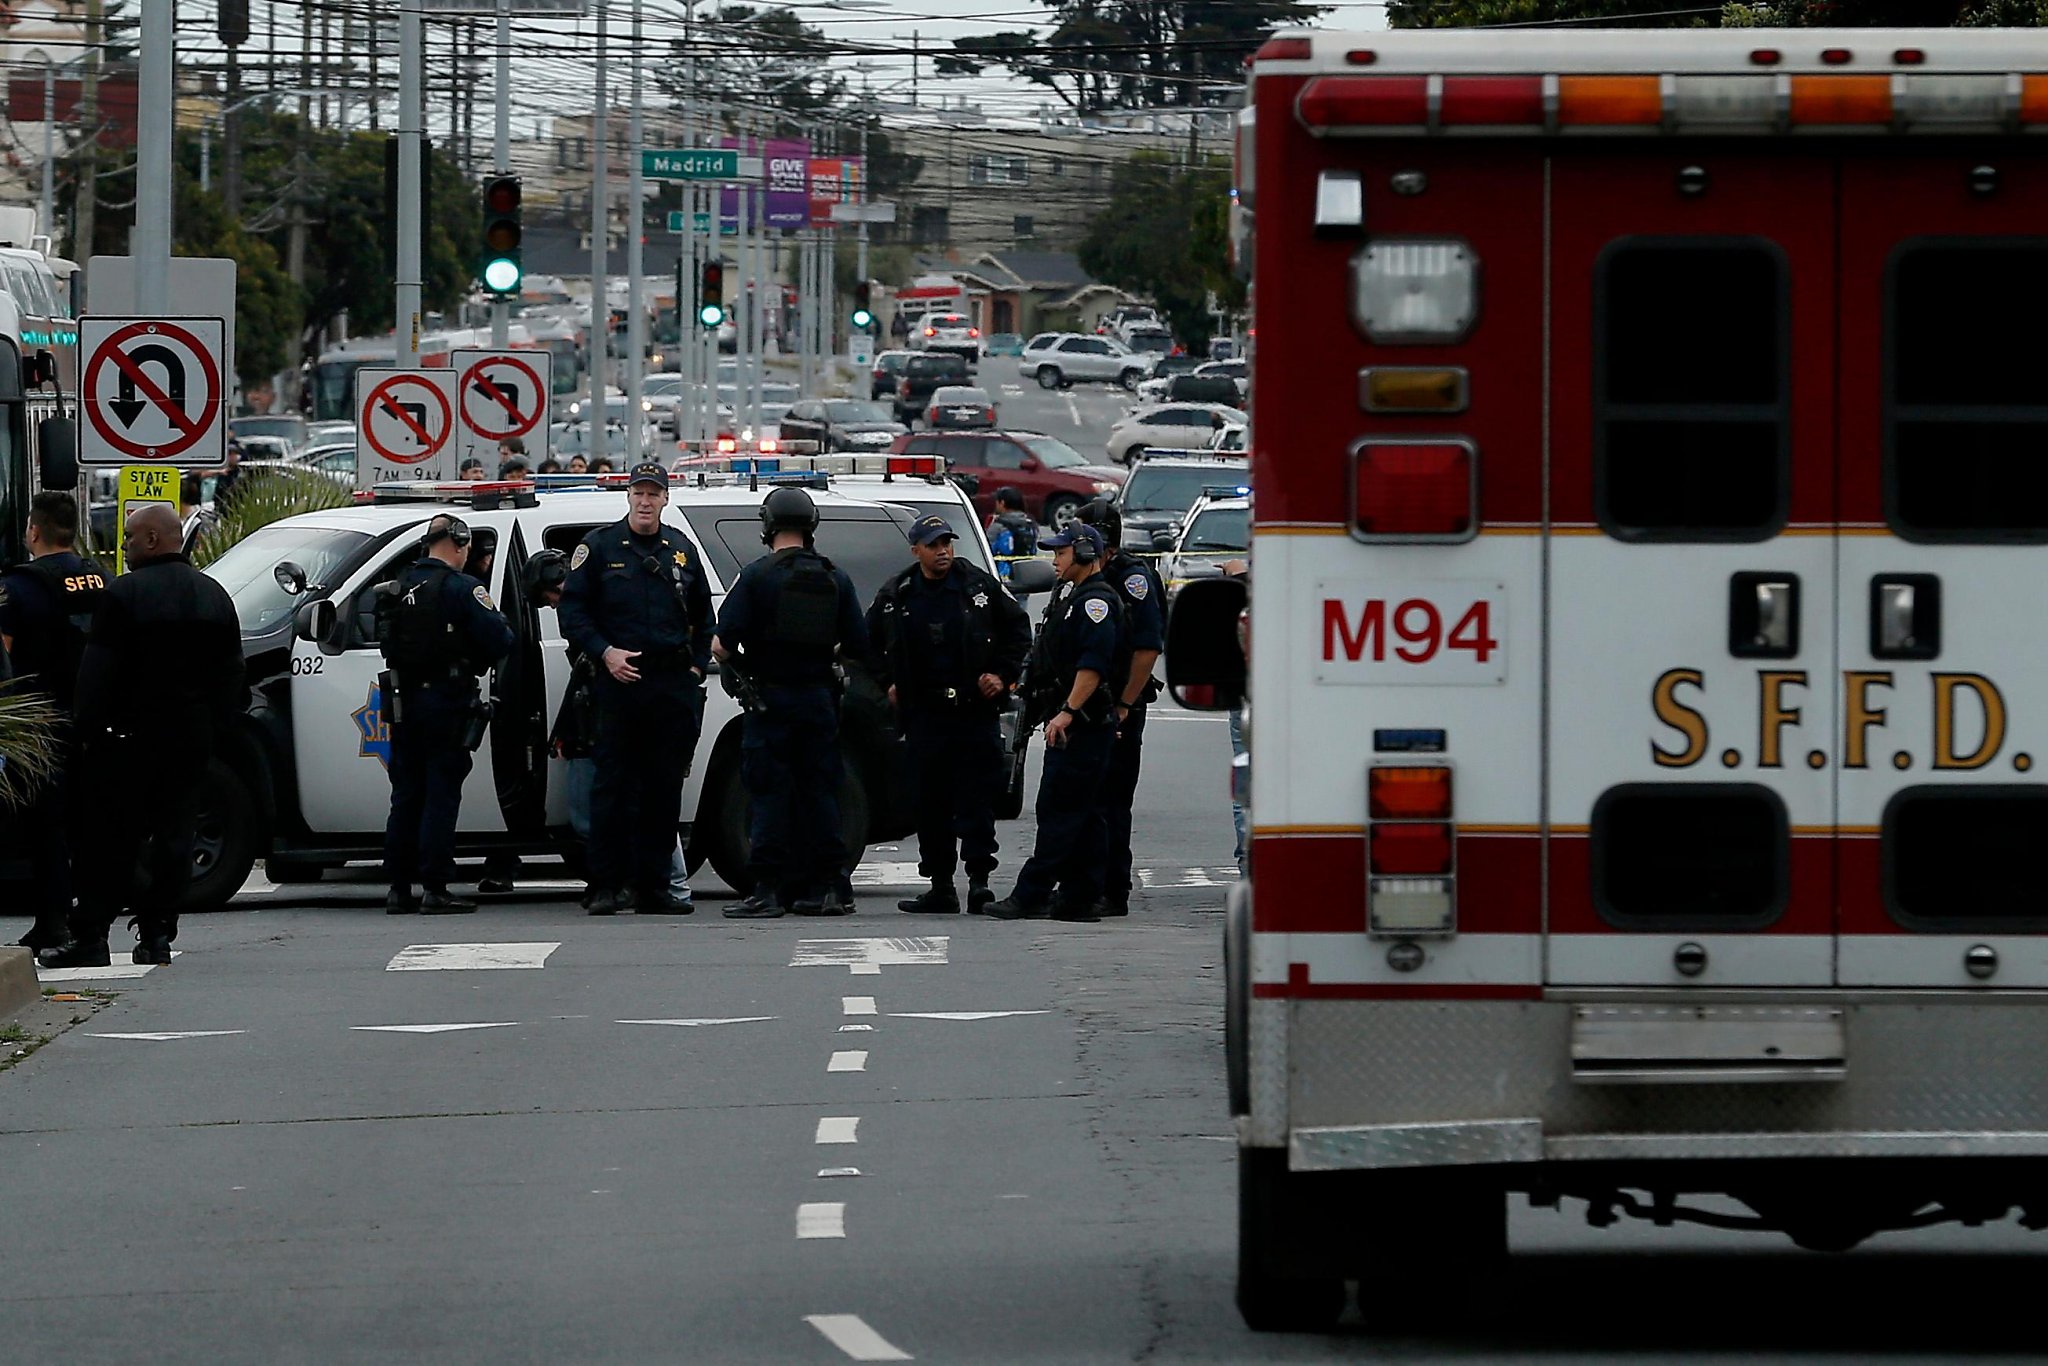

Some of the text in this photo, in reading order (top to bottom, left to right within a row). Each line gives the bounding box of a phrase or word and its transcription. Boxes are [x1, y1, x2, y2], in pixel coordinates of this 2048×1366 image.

[654, 157, 724, 172] Madrid
[769, 159, 804, 172] GIVE
[130, 471, 169, 484] STATE
[136, 486, 163, 497] LAW
[64, 574, 104, 592] SFFD
[1322, 599, 1498, 663] M94
[291, 656, 323, 676] 032
[1651, 667, 2033, 772] S.F.F.D.
